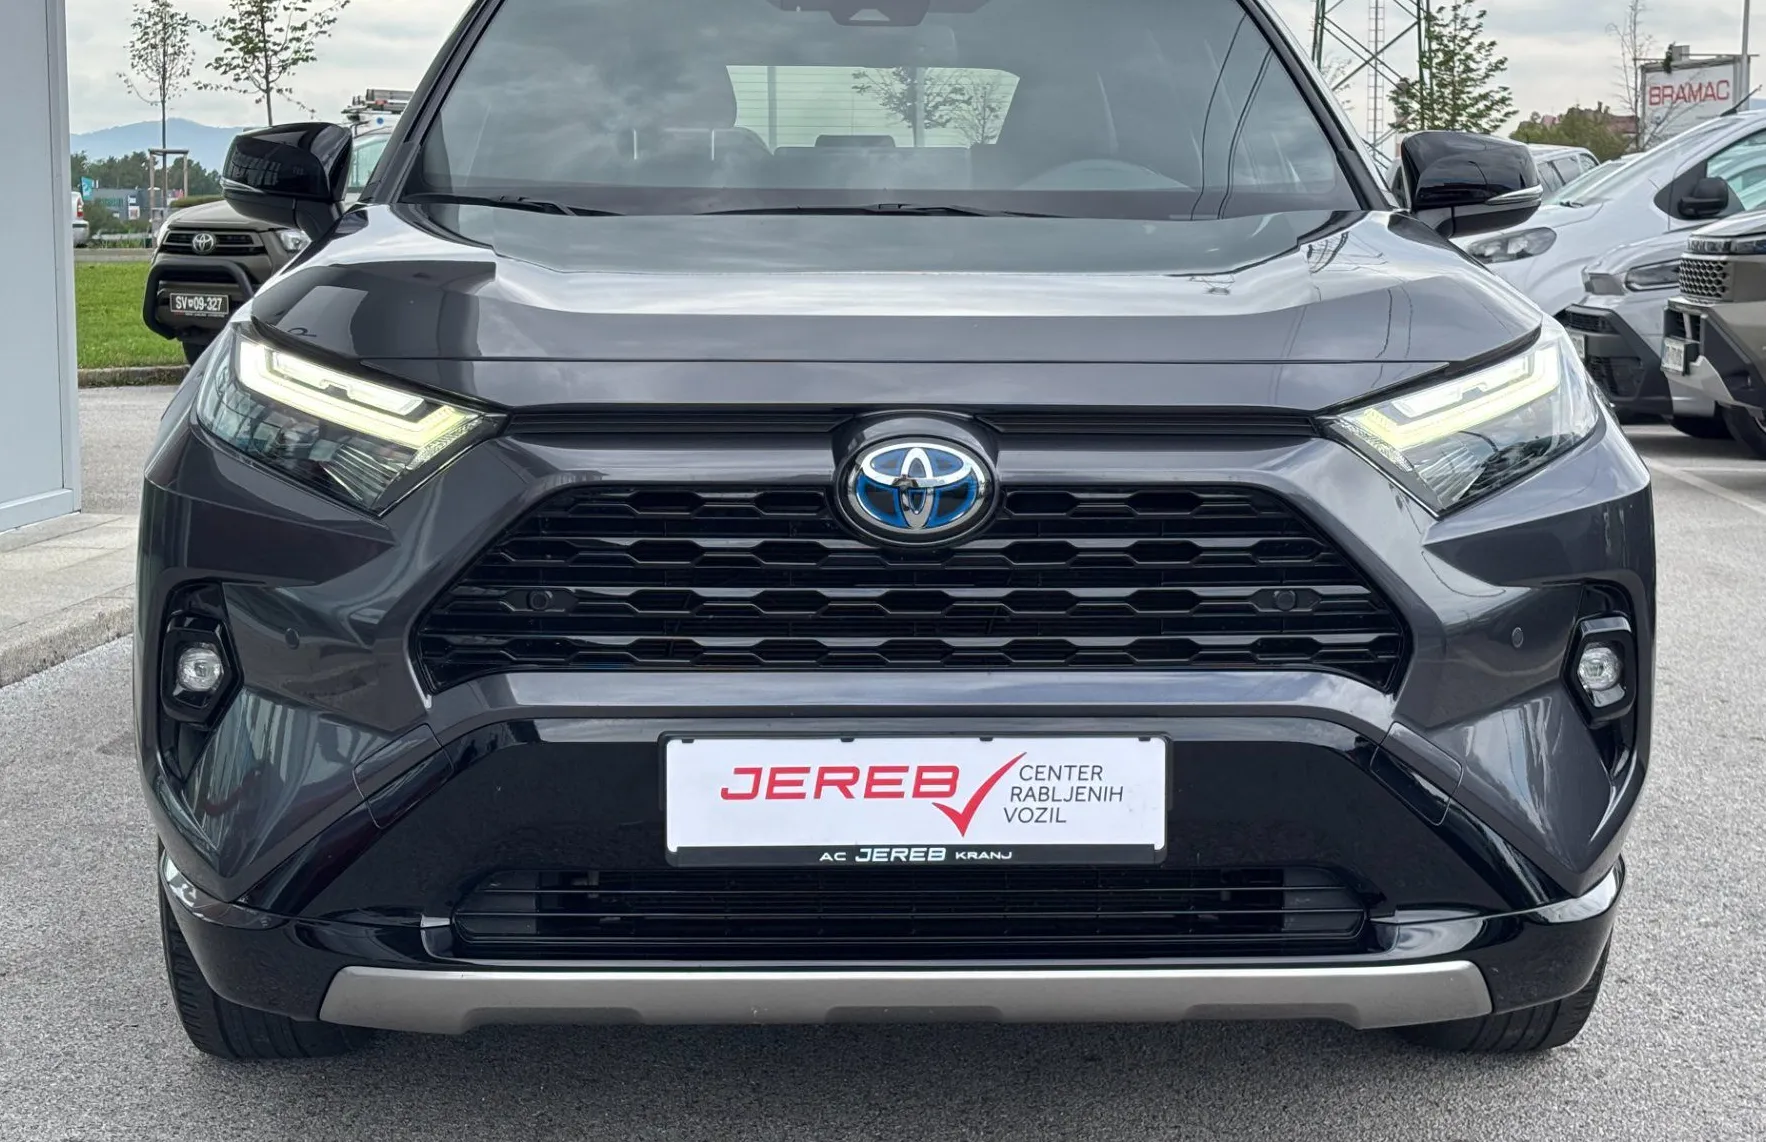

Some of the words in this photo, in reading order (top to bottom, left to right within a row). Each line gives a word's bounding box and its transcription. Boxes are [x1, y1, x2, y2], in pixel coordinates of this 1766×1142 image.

[1648, 79, 1730, 106] BRAMAC
[175, 295, 188, 310] SV
[193, 296, 223, 311] 09-327
[1019, 764, 1103, 781] CENTER
[720, 765, 960, 800] JEREB
[1010, 786, 1124, 802] RABLJENIH
[1003, 807, 1067, 823] VOZIL
[819, 851, 847, 862] AC
[854, 847, 947, 862] JEREB
[955, 850, 1013, 861] KRANJ
